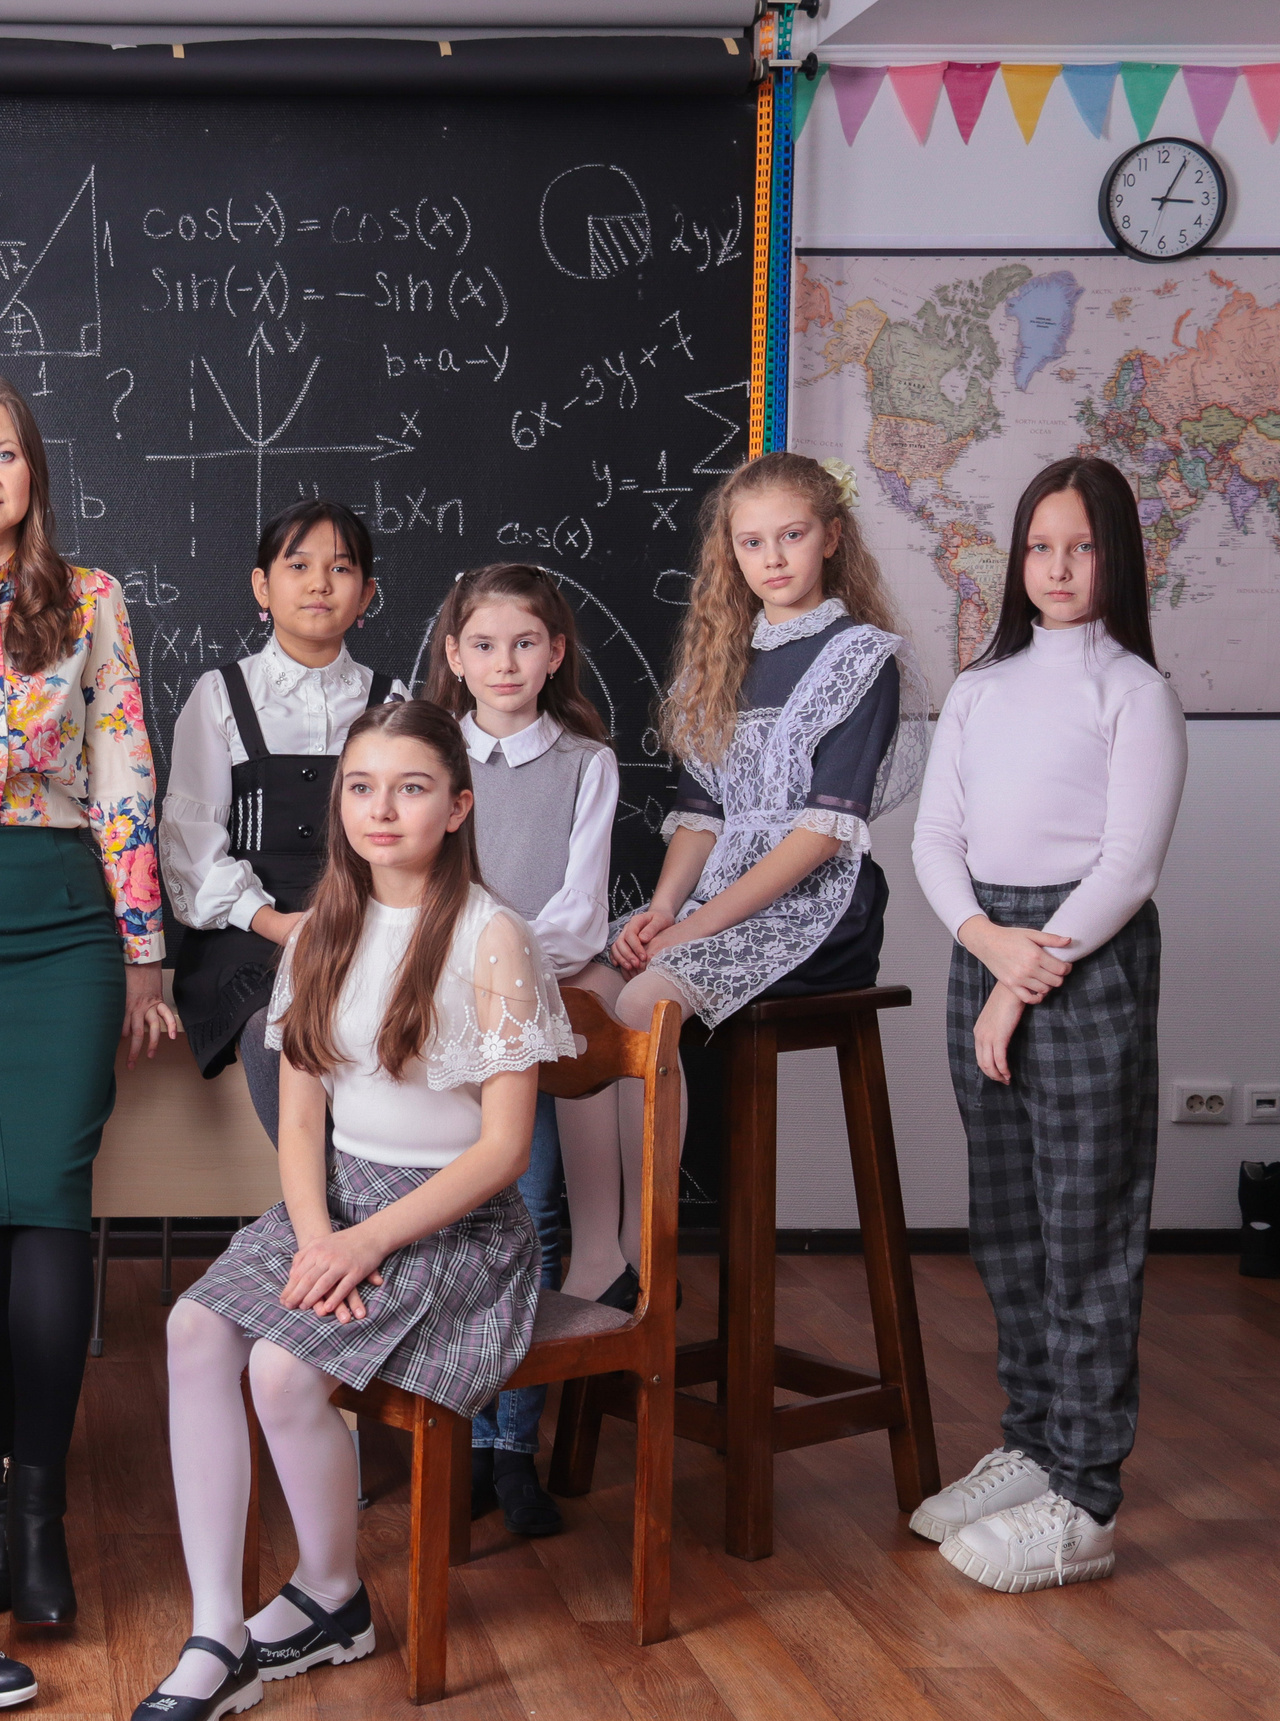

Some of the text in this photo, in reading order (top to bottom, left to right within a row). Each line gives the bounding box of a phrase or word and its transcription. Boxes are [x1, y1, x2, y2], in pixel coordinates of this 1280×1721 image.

[1158, 150, 1170, 164] 12
[1138, 158, 1148, 172] 11
[1123, 173, 1136, 187] 10
[1195, 170, 1204, 184] 2
[1116, 194, 1124, 208] 9
[1201, 191, 1210, 205] 3
[1122, 215, 1131, 229] 8
[1193, 214, 1202, 228] 4
[1140, 230, 1148, 244] 7
[1158, 236, 1166, 249] 6
[1178, 229, 1187, 243] 5
[898, 380, 926, 390] CANADA
[1038, 418, 1068, 426] ATLANTIC
